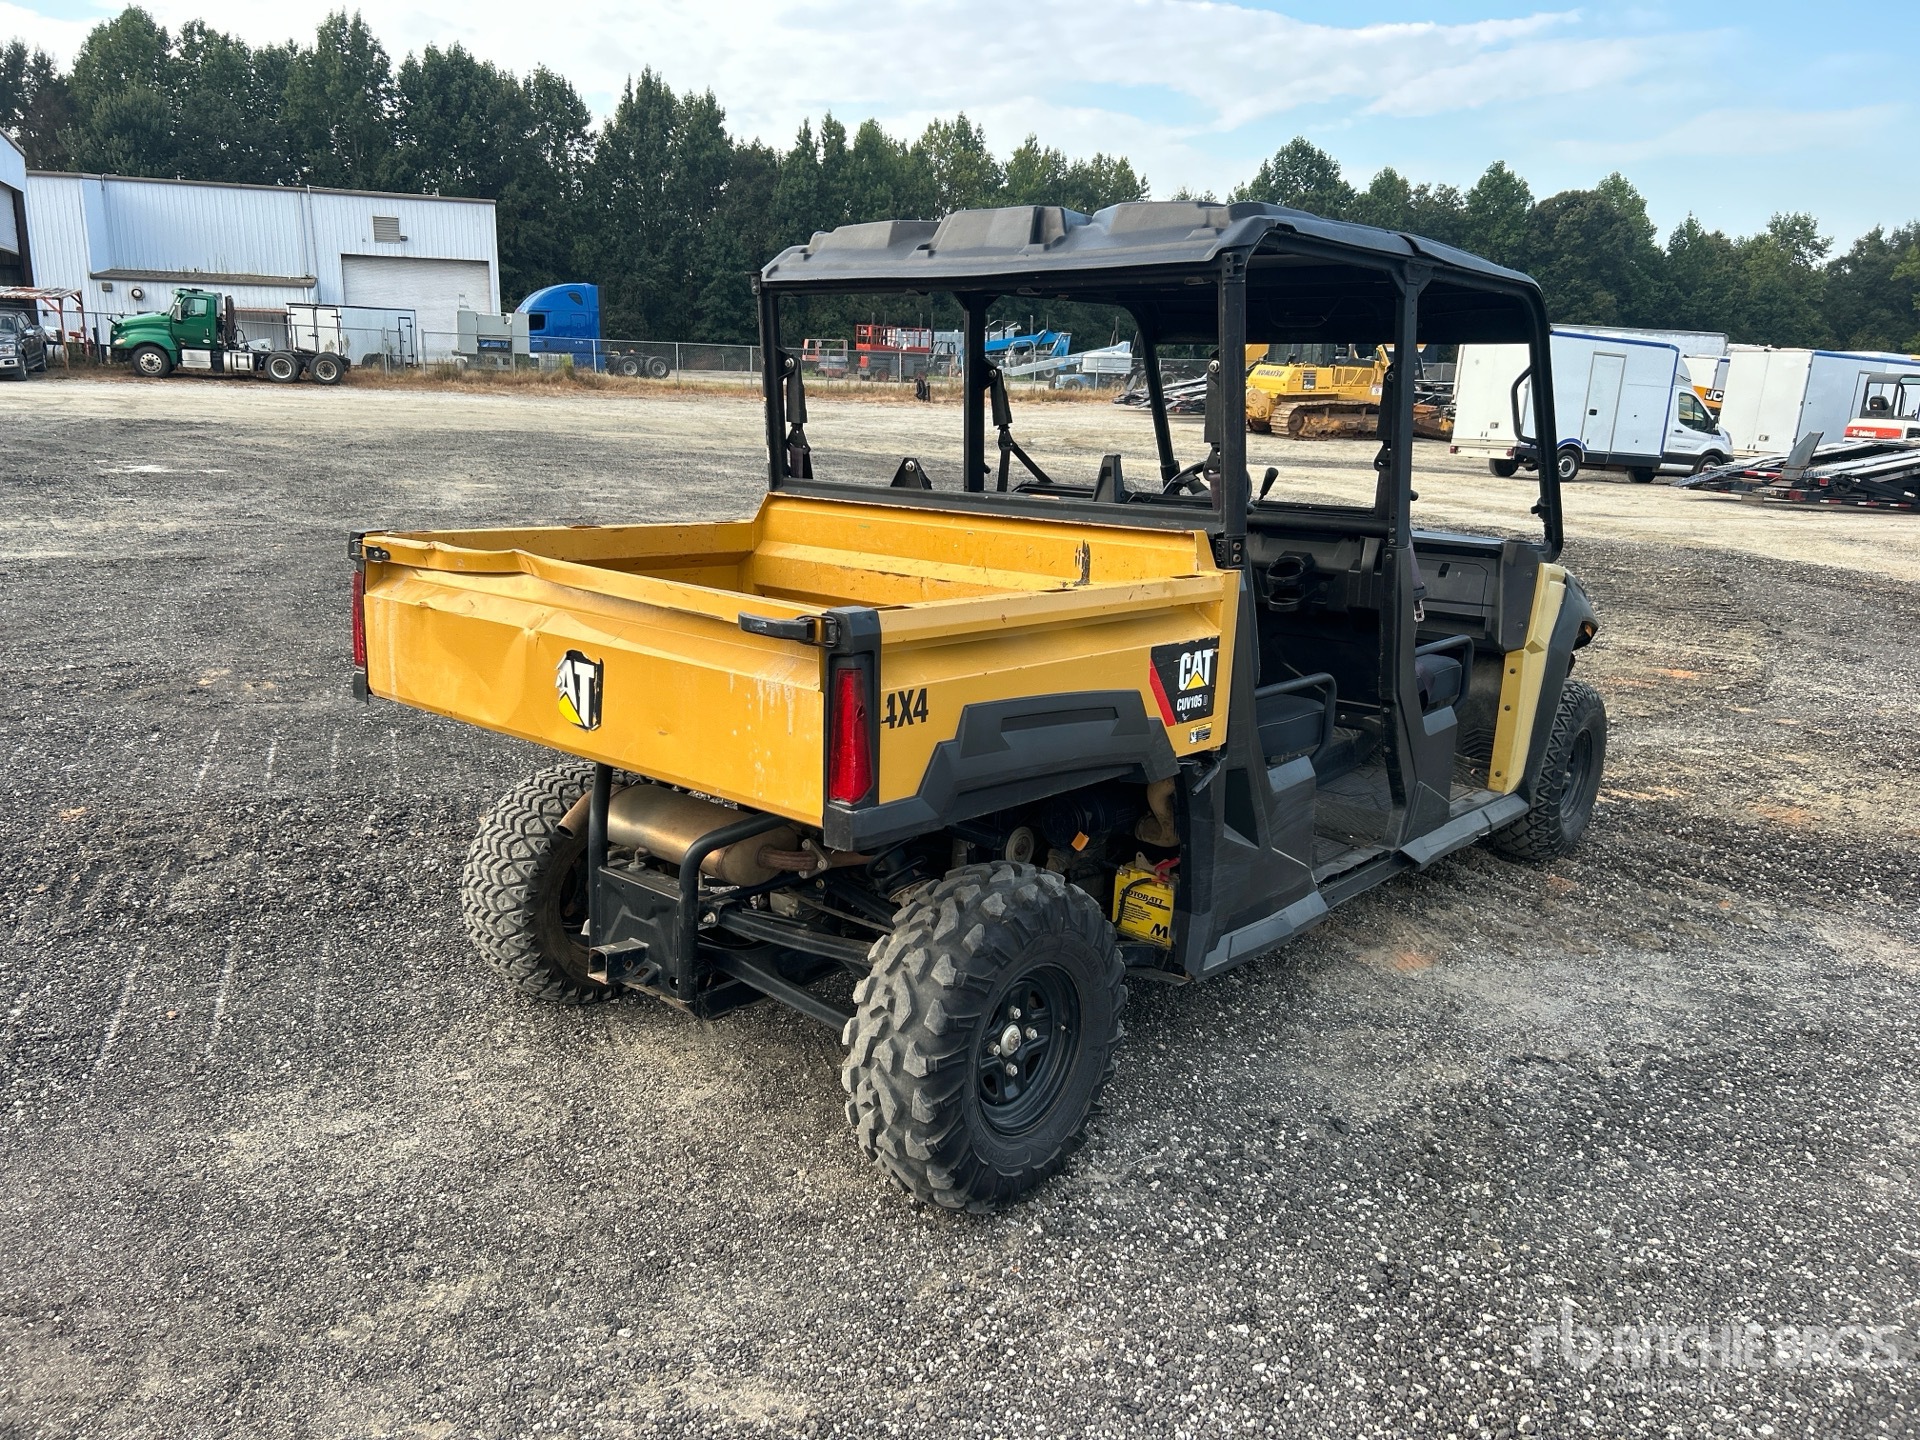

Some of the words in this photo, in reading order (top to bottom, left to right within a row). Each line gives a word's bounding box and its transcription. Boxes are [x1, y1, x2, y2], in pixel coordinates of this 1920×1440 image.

[1256, 369, 1285, 378] KOMATSU
[1705, 389, 1723, 402] JC
[1178, 648, 1214, 691] CAT
[555, 658, 596, 728] AT
[880, 687, 929, 730] 4X4
[1176, 694, 1203, 712] CUV105
[1150, 923, 1169, 938] M
